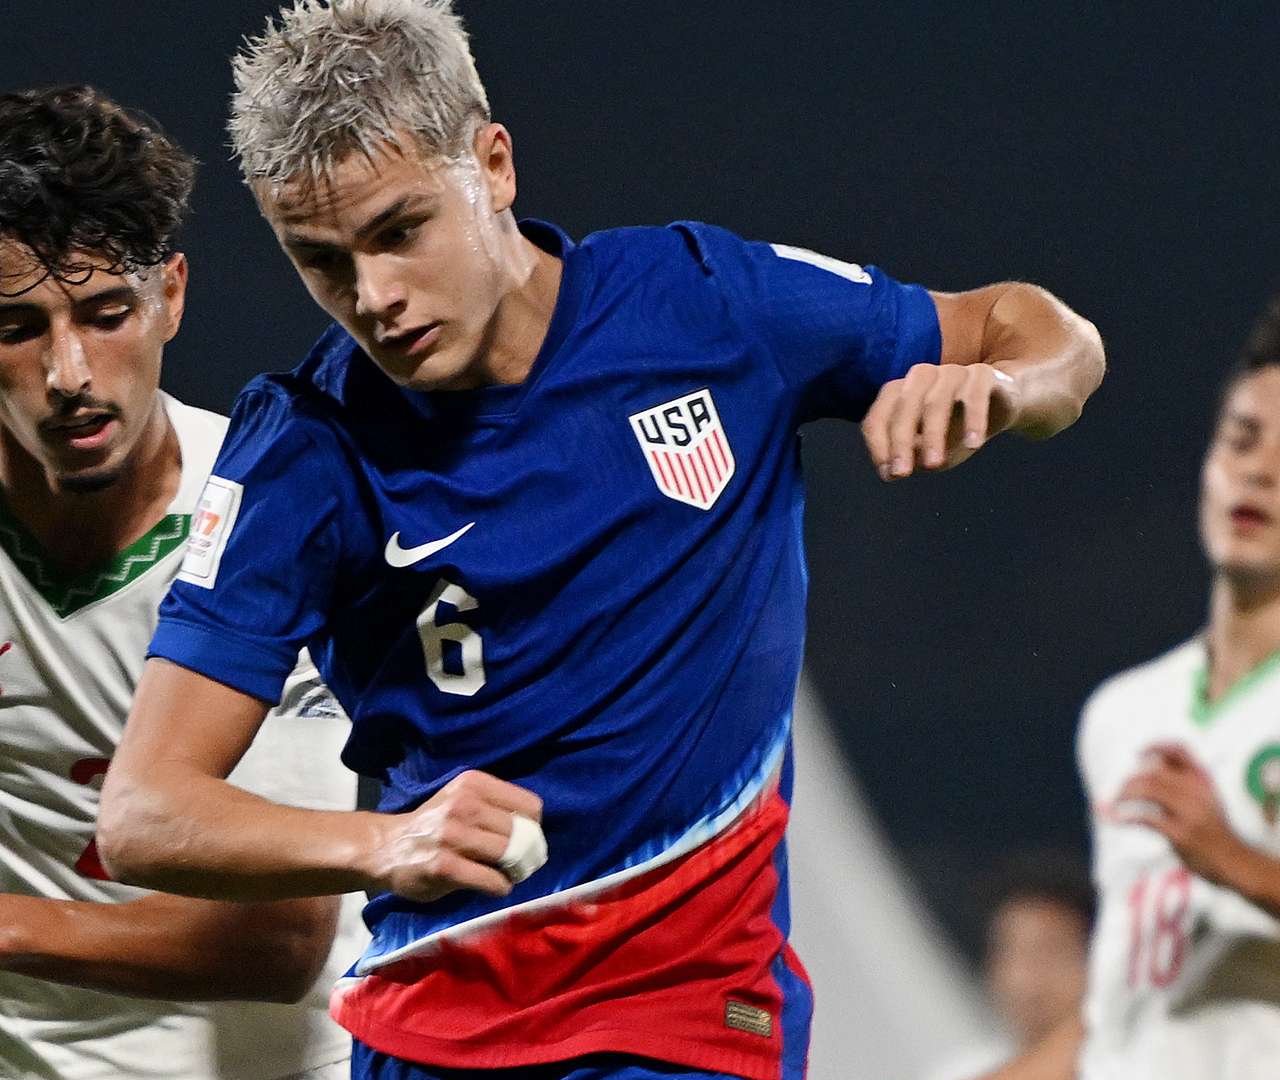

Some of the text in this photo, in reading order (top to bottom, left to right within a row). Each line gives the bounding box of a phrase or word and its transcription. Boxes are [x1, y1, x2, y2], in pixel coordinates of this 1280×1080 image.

[638, 397, 711, 447] USA
[416, 579, 487, 697] 6
[1127, 864, 1191, 990] 18
